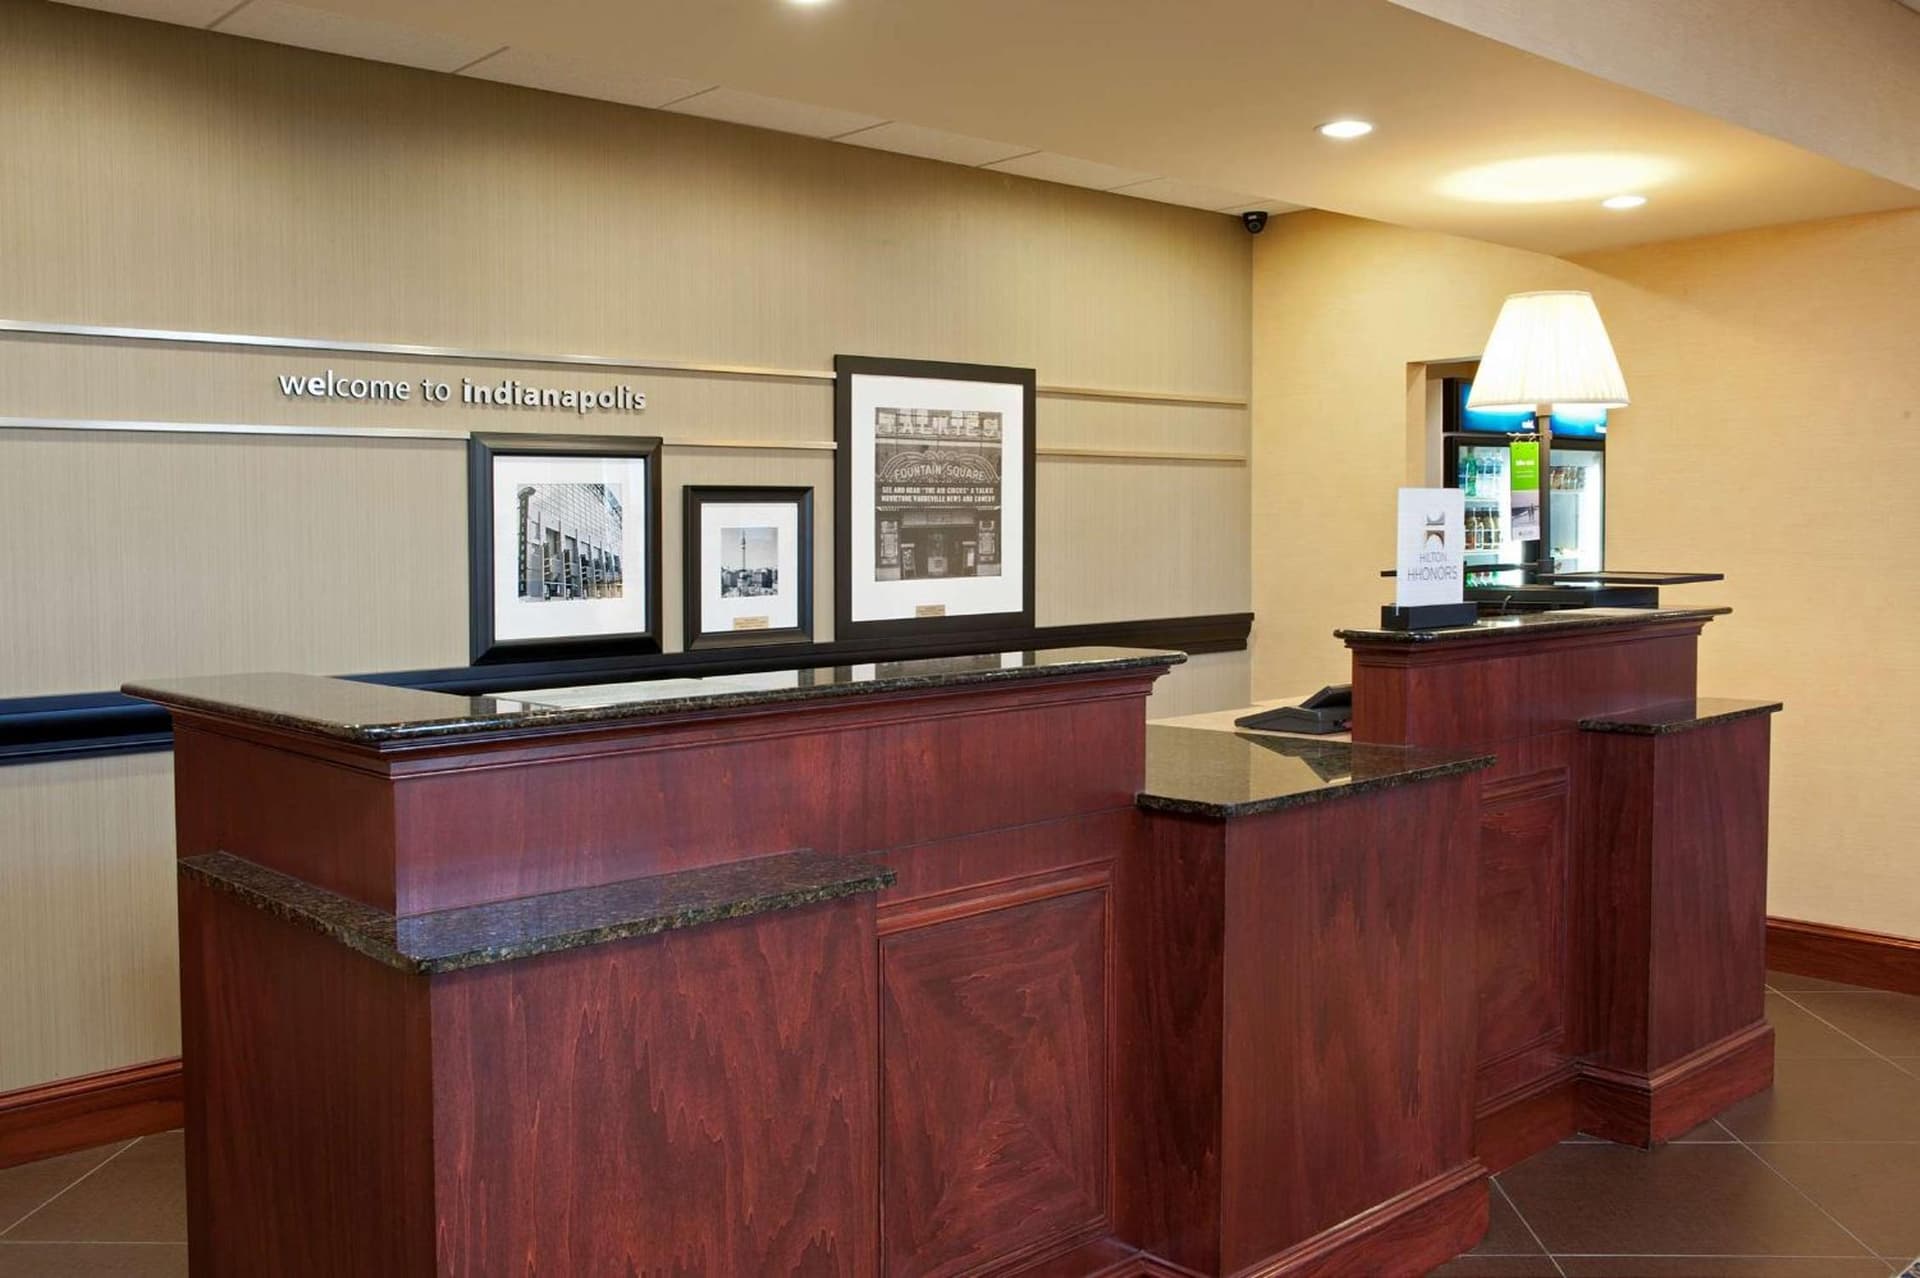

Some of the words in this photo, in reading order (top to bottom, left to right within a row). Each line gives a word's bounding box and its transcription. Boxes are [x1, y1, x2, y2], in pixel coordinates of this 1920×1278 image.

[279, 370, 411, 400] welcome
[421, 378, 451, 401] to
[462, 377, 647, 414] indianapolis
[894, 464, 942, 480] FOUNTAIN
[946, 464, 985, 480] SQUARE
[1419, 552, 1447, 563] HILTON
[1407, 567, 1458, 581] HHONORS
